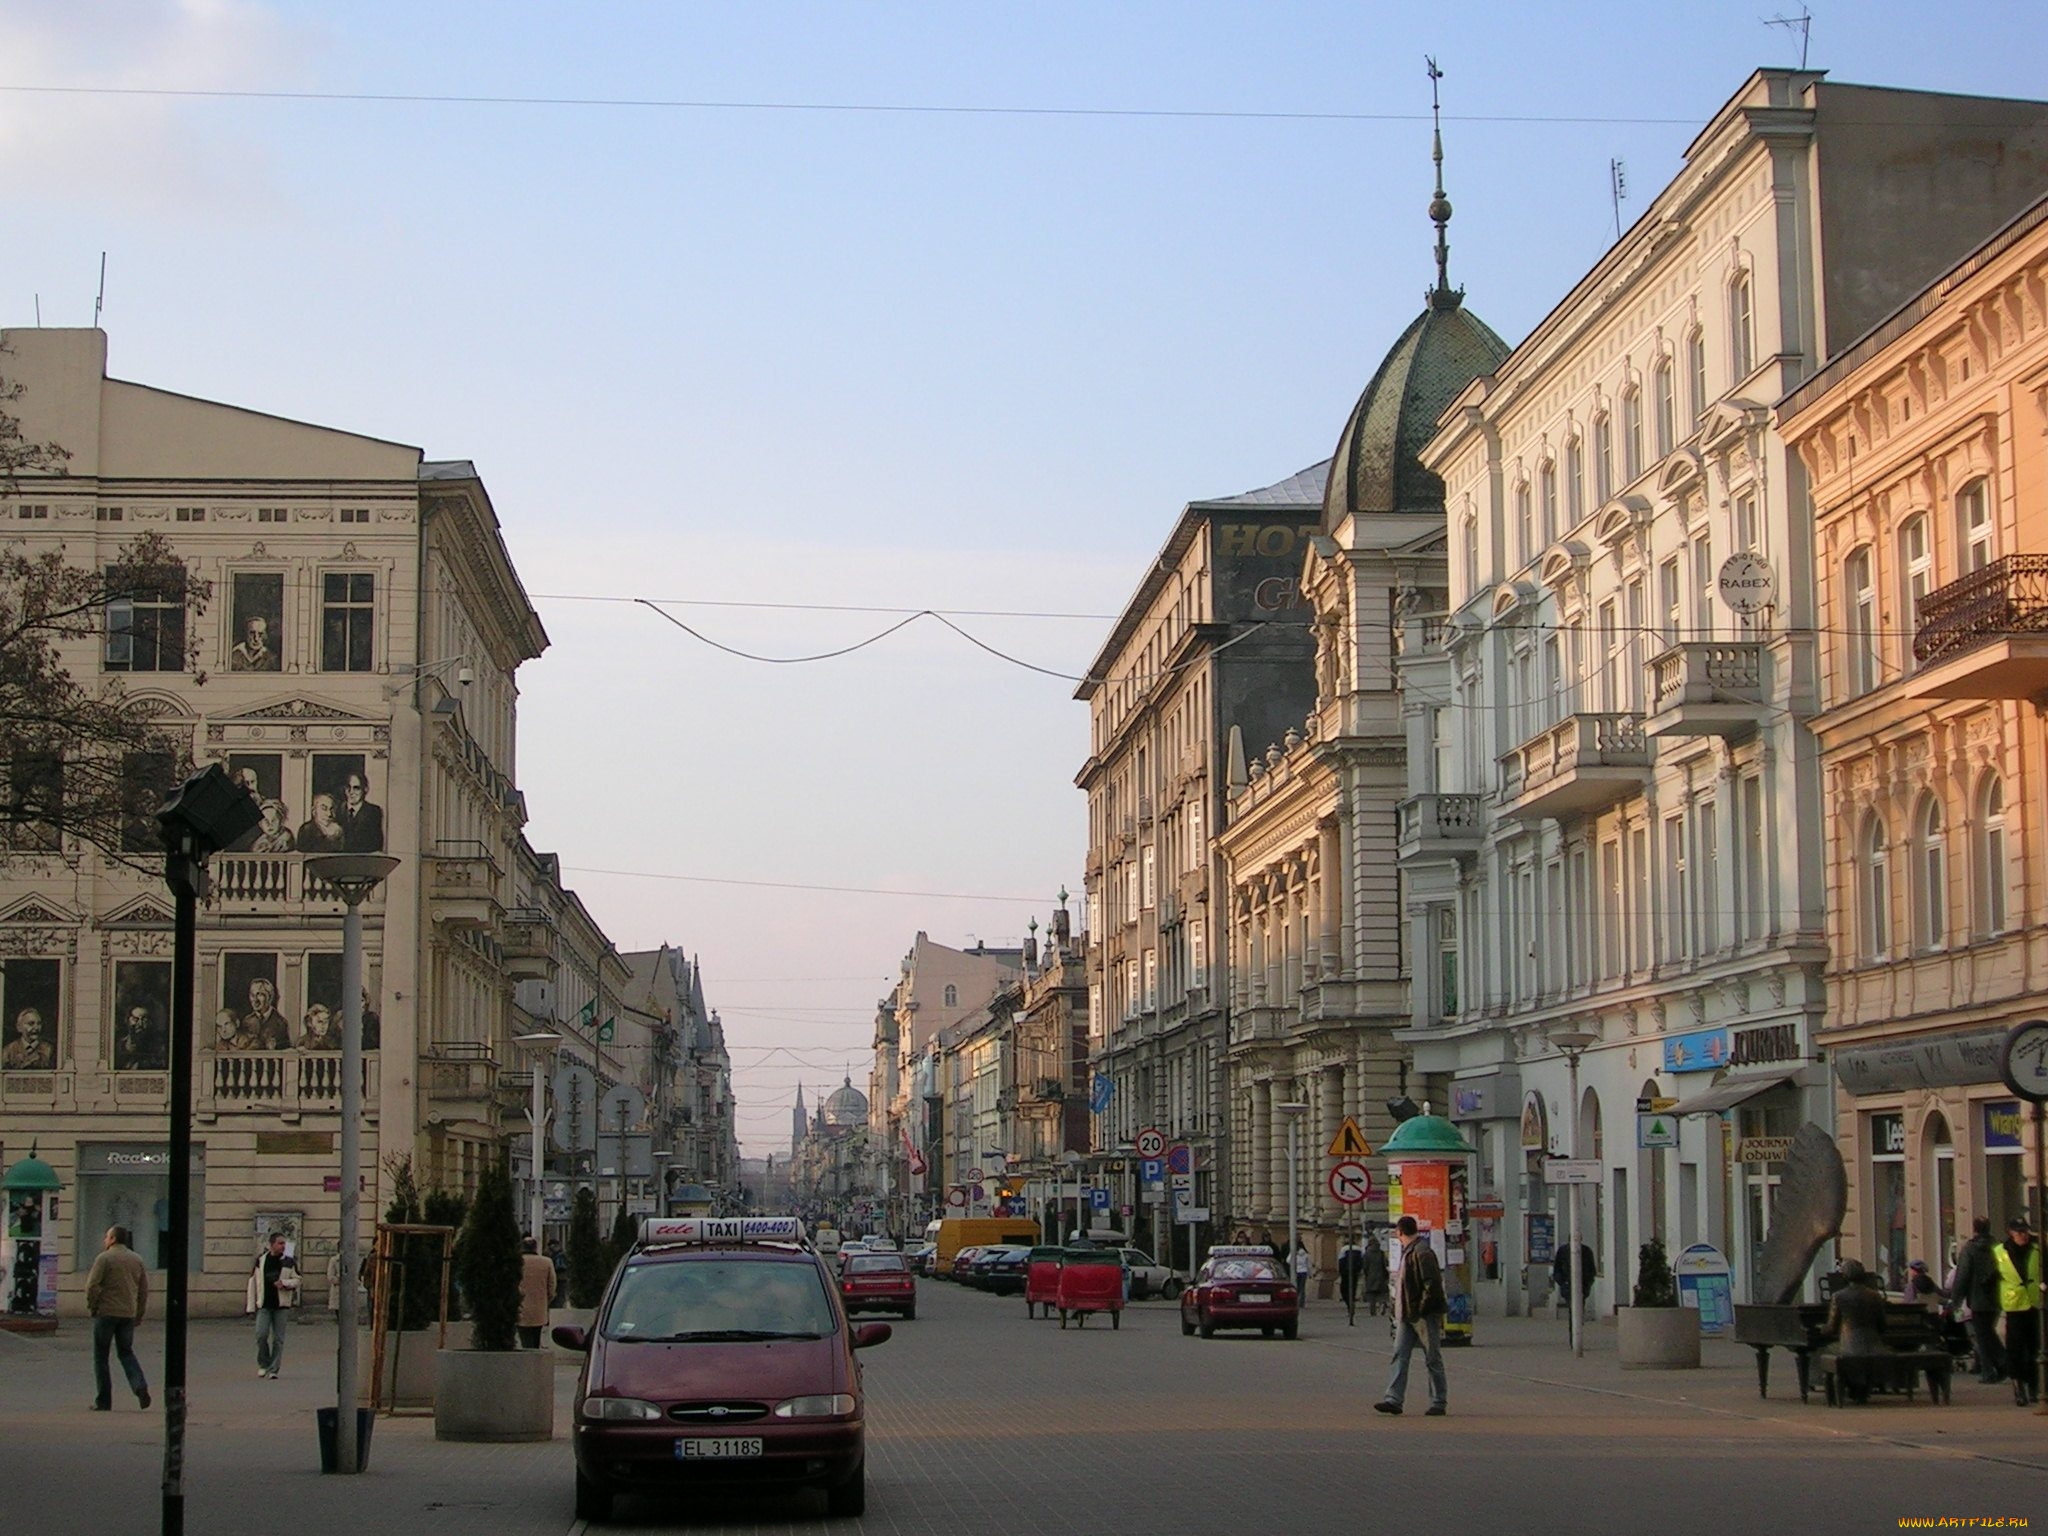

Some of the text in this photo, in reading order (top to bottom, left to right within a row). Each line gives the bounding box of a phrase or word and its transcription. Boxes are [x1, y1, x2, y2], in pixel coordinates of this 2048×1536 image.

[1720, 578, 1771, 589] RABEX
[1731, 1023, 1800, 1066] JOURNAL
[1885, 1119, 1904, 1151] Lee
[1142, 1137, 1161, 1151] 20
[107, 1151, 170, 1164] Reebok
[1145, 1161, 1159, 1179] P
[1094, 1191, 1106, 1207] P
[656, 1223, 694, 1236] tele
[706, 1223, 738, 1237] TAXI
[684, 1440, 760, 1456] EL 3118S
